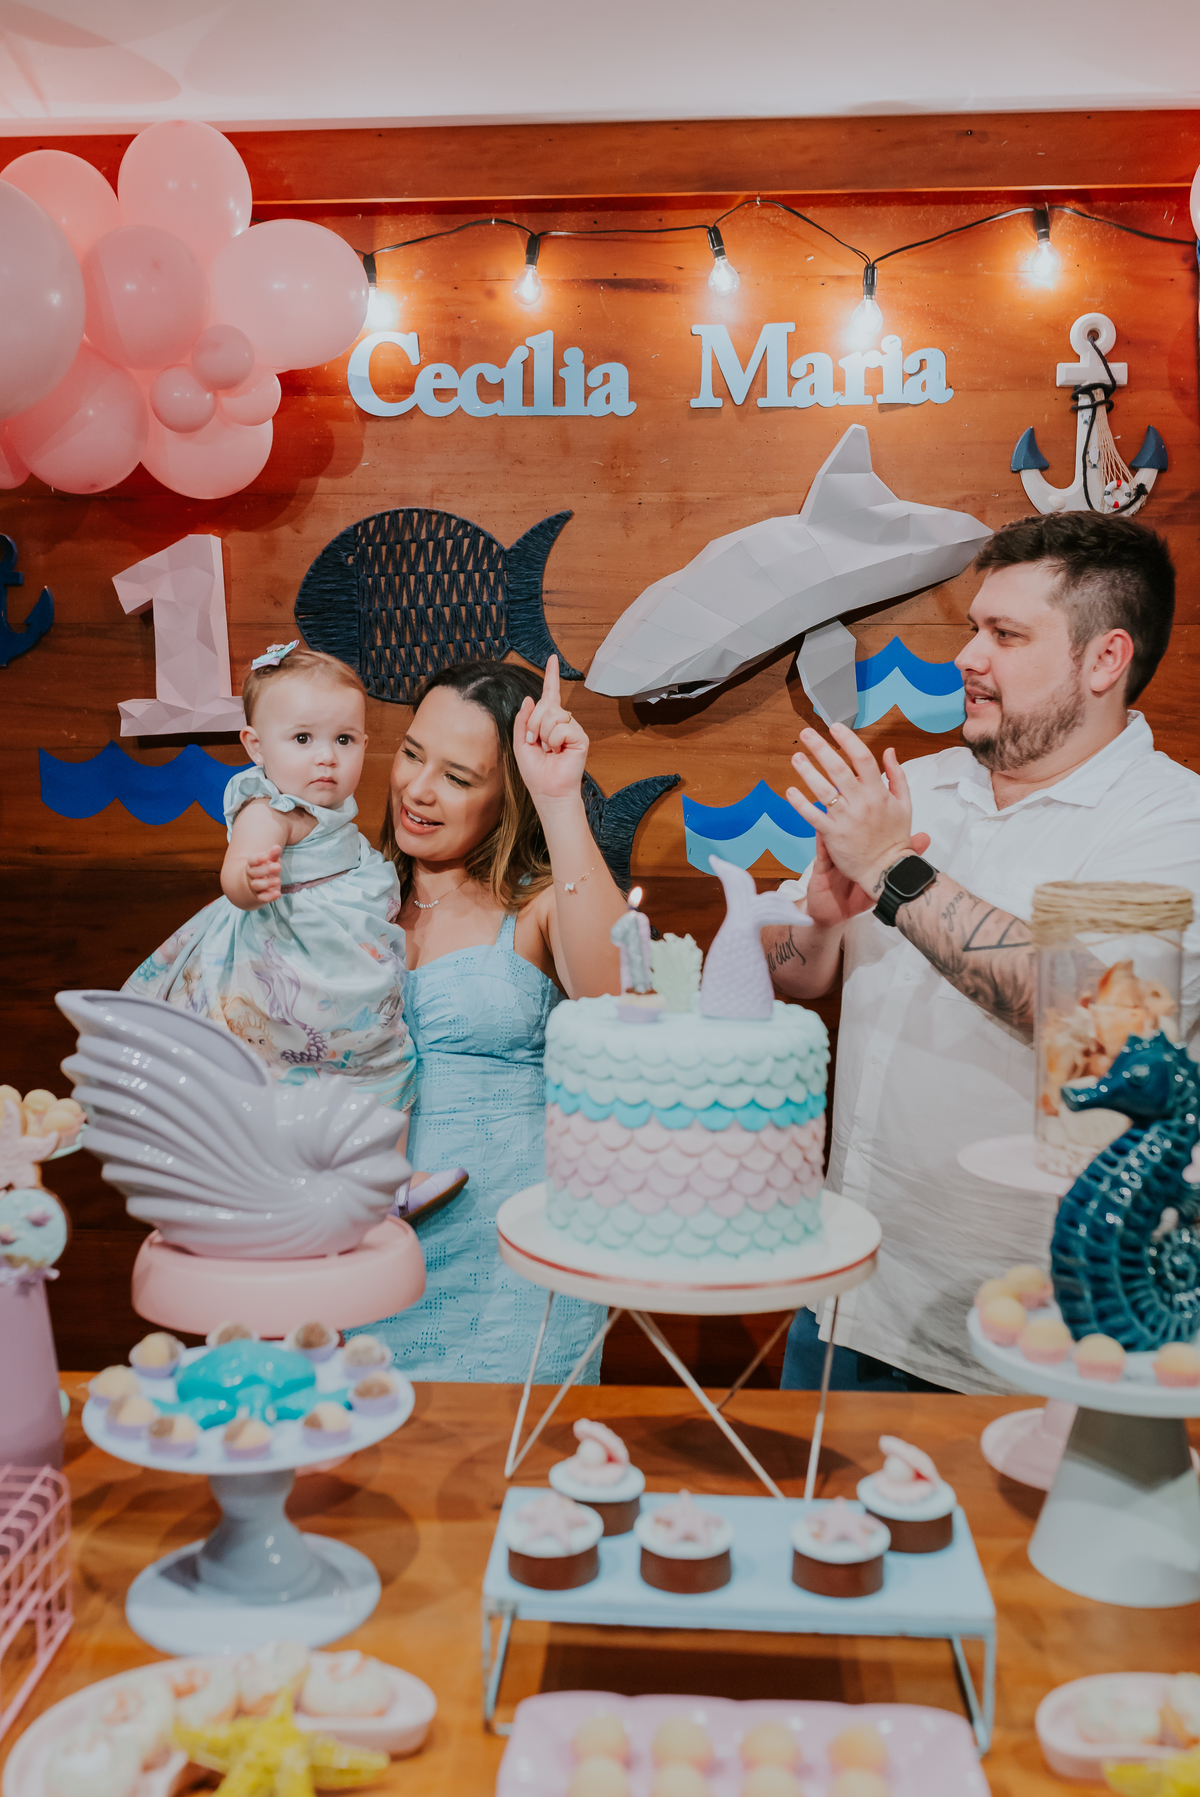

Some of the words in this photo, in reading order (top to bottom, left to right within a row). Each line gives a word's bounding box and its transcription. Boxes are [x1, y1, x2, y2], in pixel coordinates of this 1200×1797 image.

[347, 330, 637, 417] Cecília
[690, 322, 954, 408] Maria
[112, 534, 247, 737] 1
[610, 911, 651, 994] 1
